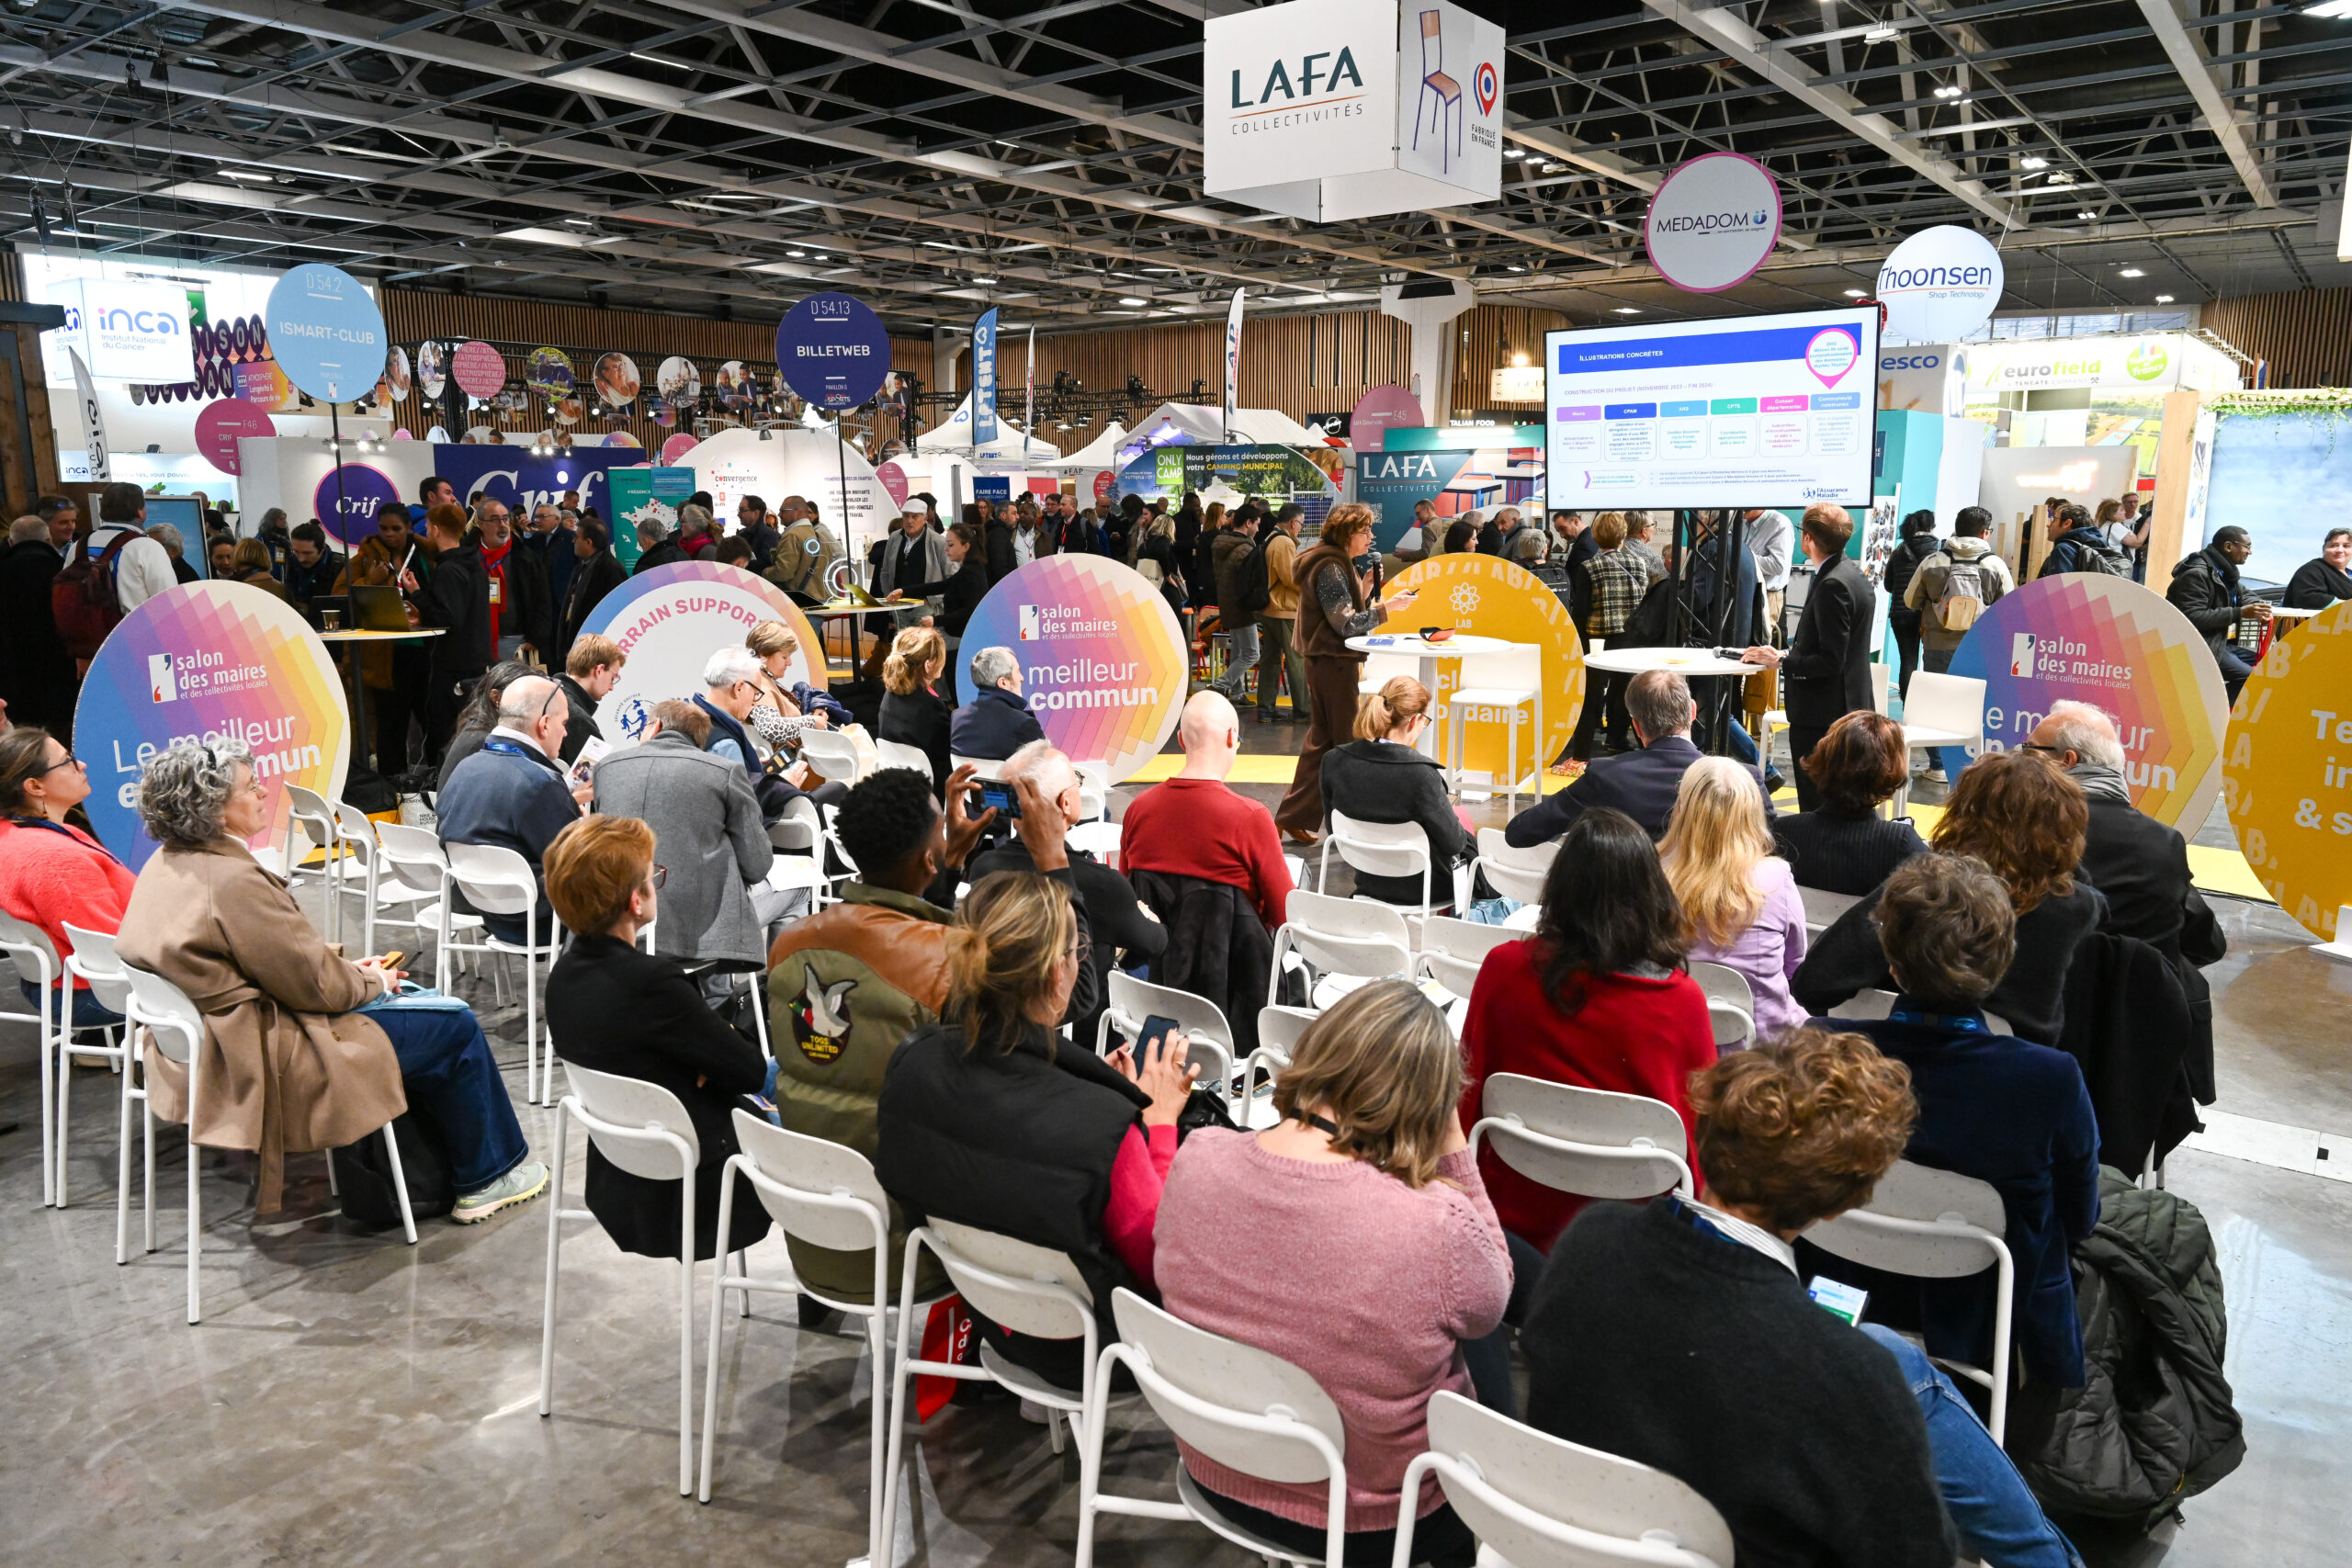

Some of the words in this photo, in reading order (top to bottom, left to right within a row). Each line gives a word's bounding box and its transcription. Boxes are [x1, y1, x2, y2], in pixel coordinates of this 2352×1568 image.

[1232, 45, 1363, 108] LAFA
[1232, 103, 1363, 135] COLLECTIVITÉS
[1472, 133, 1477, 141] EN
[1478, 136, 1496, 149] FRANCE
[1657, 212, 1748, 233] MEDADOM
[306, 273, 313, 288] D
[318, 276, 343, 293] 54.2
[1879, 265, 1992, 290] Thoonsen
[810, 301, 819, 314] D
[821, 301, 850, 314] 54.13
[97, 307, 180, 335] inca
[101, 333, 130, 343] Institut
[131, 335, 166, 344] National
[279, 321, 375, 344] ISMART-CLUB
[116, 343, 146, 351] Cancer
[797, 345, 871, 356] BILLETWEB
[1579, 353, 1624, 361] ILLUSTRATIONS
[1626, 350, 1663, 358] CONCRÈTES
[1880, 355, 1939, 370] esco
[2004, 360, 2101, 378] eurofield
[249, 384, 269, 394] Longévité
[978, 346, 994, 427] LPTENT
[1636, 384, 1669, 392] (NOVEMBRE
[1393, 410, 1407, 421] E45
[243, 420, 257, 430] F46
[1158, 454, 1182, 466] ONLY
[1205, 452, 1230, 462] gérons
[1241, 452, 1289, 462] développons
[1242, 462, 1284, 470] MUNICIPAL
[1157, 467, 1182, 479] CAMP
[1363, 454, 1437, 479] LAFA
[715, 475, 758, 483] convergence
[1363, 484, 1437, 492] COLLECTIVITÉS
[467, 470, 605, 520] Crif
[335, 496, 380, 518] Crif
[1042, 604, 1080, 618] salon
[616, 604, 672, 660] RRAIN
[674, 598, 763, 629] SUPPOR
[1043, 619, 1067, 633] des
[1071, 618, 1118, 632] maires
[1455, 618, 1472, 628] LAB
[2039, 637, 2086, 656] salon
[176, 649, 223, 671] salon
[2038, 653, 2066, 673] des
[2072, 660, 2132, 680] maires
[179, 671, 209, 691] des
[214, 664, 267, 684] maires
[1028, 658, 1138, 685] meilleur
[2045, 671, 2057, 682] des
[2060, 674, 2102, 686] collectivités
[2105, 677, 2131, 689] locales
[180, 691, 188, 700] et
[190, 688, 203, 698] des
[204, 682, 243, 696] collectivités
[245, 678, 268, 689] locales
[1029, 686, 1158, 711] commun
[1983, 706, 2004, 729] e
[113, 739, 156, 773] Le
[254, 744, 322, 778] mun
[2294, 798, 2323, 829] &
[801, 1042, 839, 1054] UNLIMITED
[809, 1035, 829, 1045] TOGS
